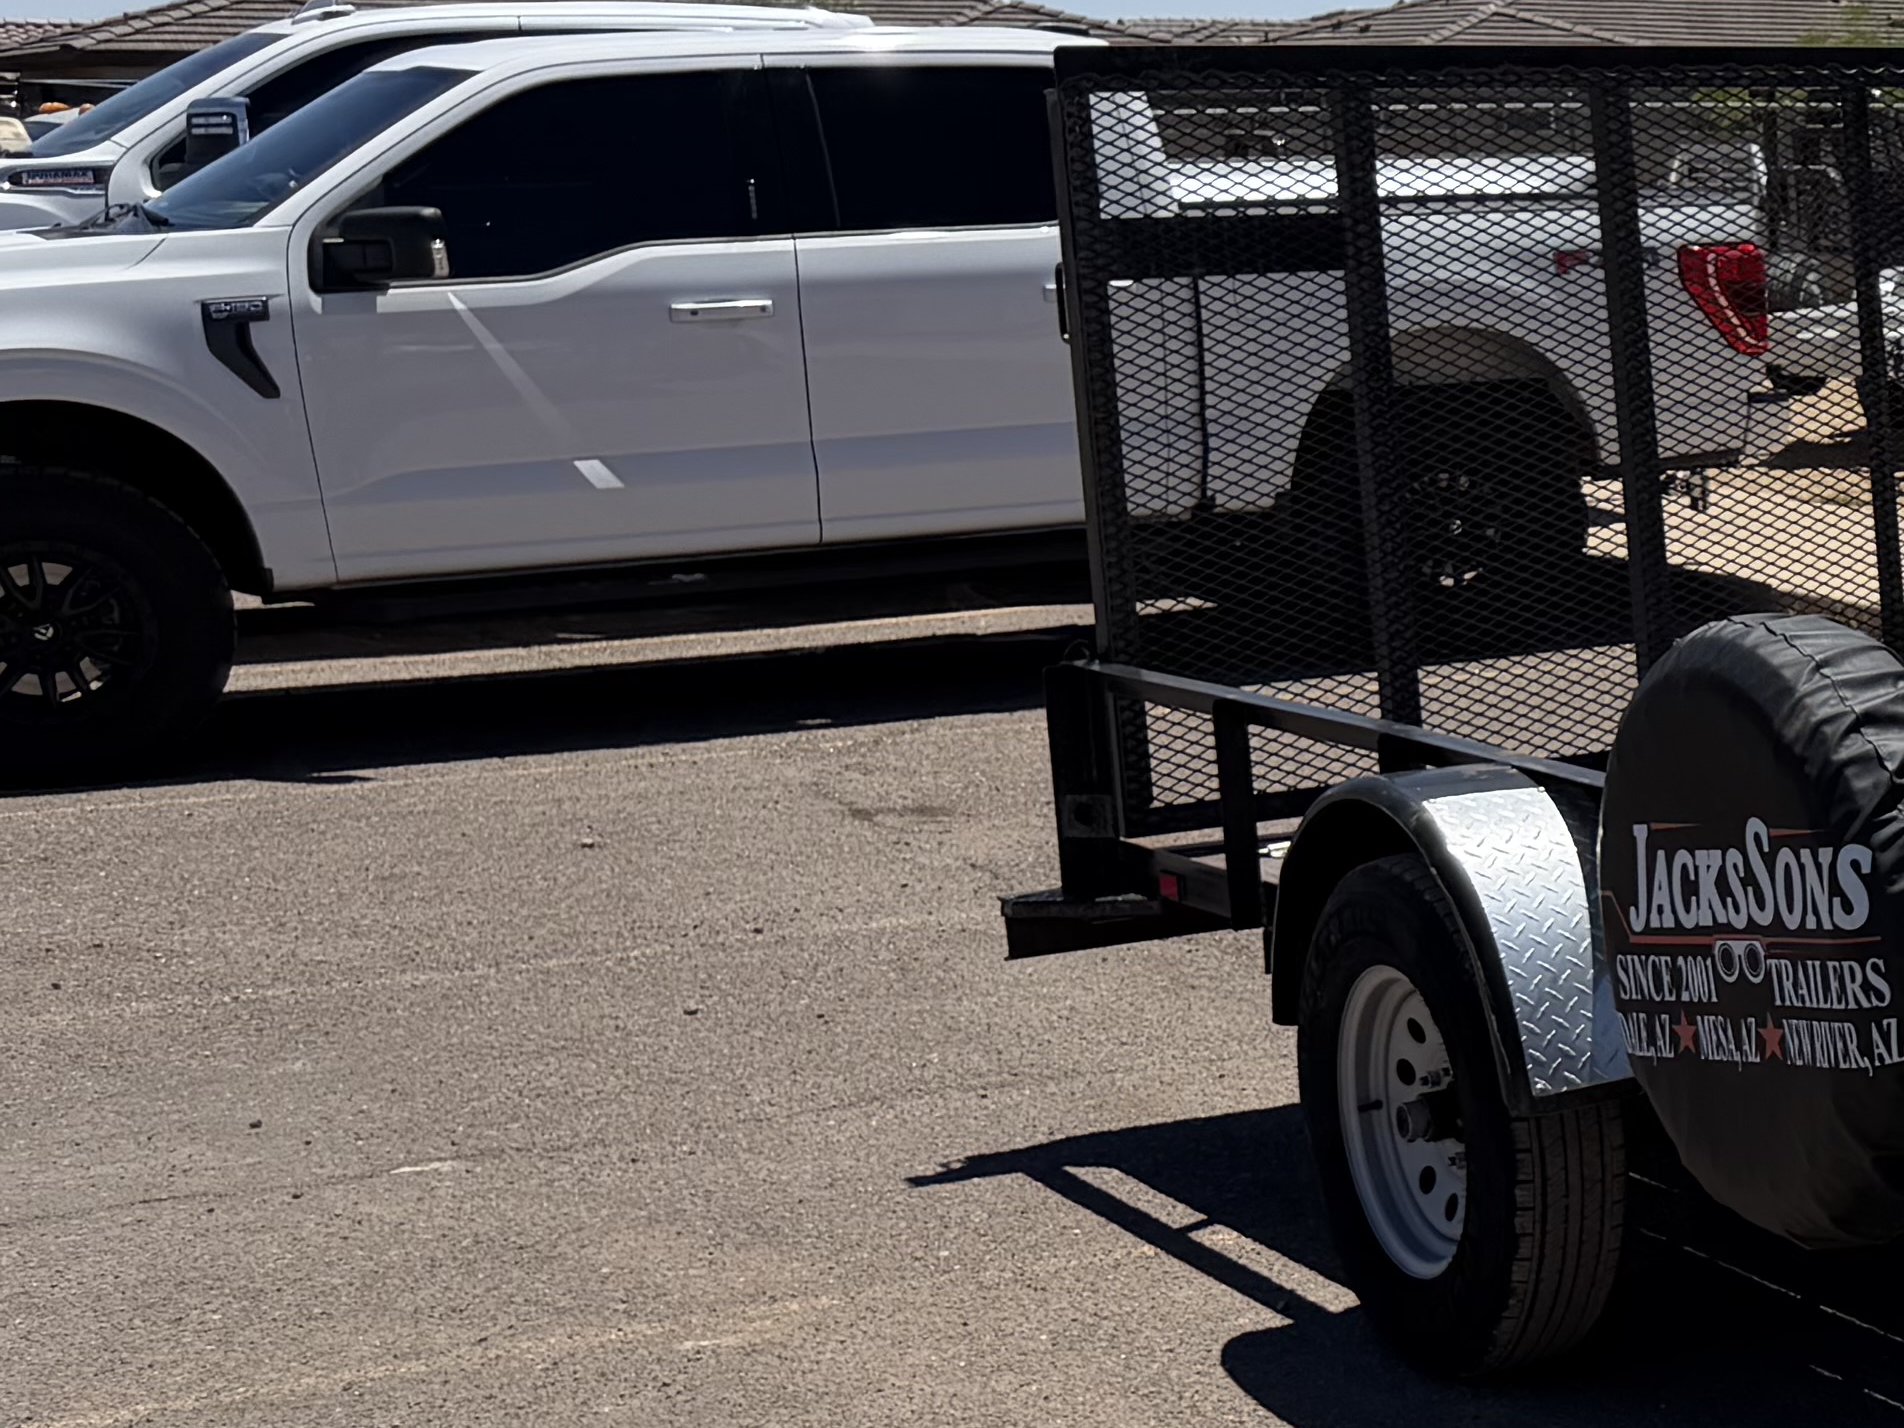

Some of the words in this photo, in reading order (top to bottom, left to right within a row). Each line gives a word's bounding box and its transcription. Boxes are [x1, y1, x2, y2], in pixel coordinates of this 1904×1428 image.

[1616, 954, 1676, 1002] SINCE
[1676, 955, 1718, 1003] 2001
[1766, 957, 1892, 1009] TRAILERS
[1655, 1013, 1675, 1058] AZ
[1740, 1017, 1760, 1063] AZ
